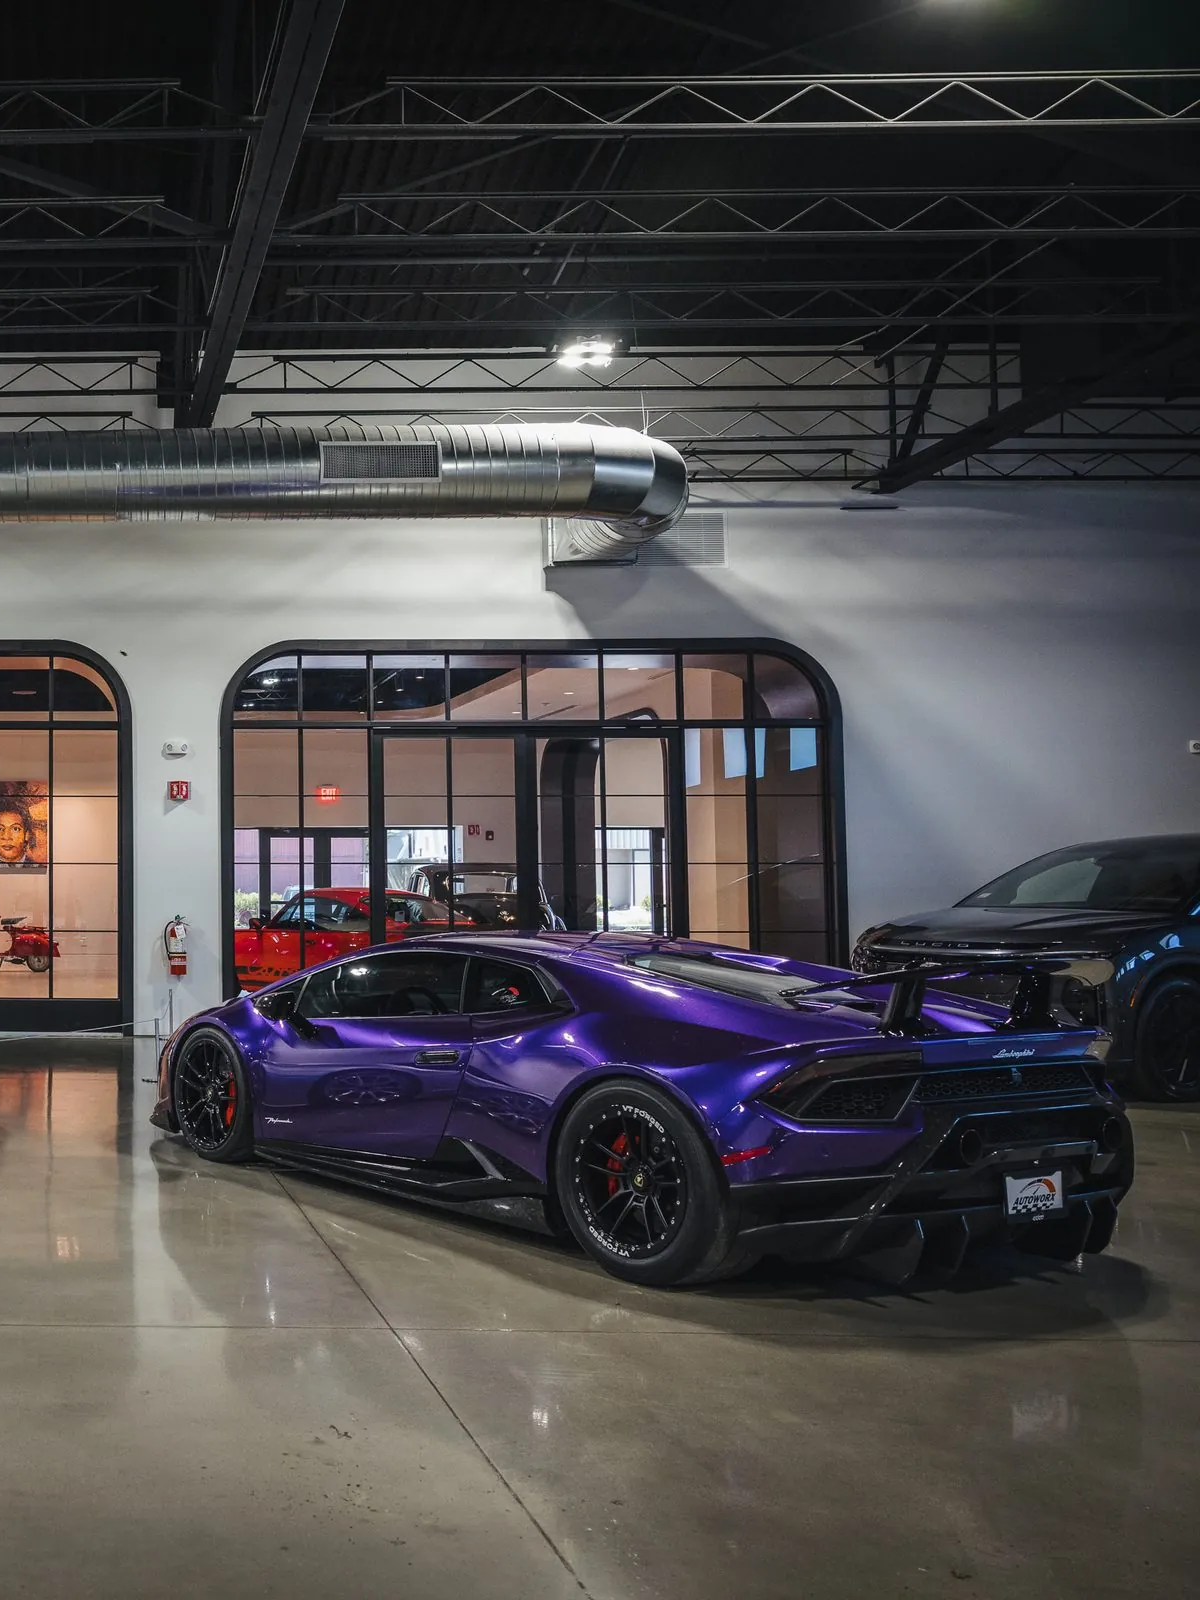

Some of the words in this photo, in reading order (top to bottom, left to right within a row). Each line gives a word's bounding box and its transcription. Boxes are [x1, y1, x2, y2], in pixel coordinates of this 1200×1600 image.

[321, 788, 337, 800] EXIT
[900, 940, 969, 948] LUCID
[622, 1104, 634, 1113] VT
[634, 1107, 665, 1134] FORGED
[1012, 1192, 1056, 1206] AUTOWORX
[589, 1225, 618, 1253] FORGED
[617, 1249, 630, 1258] VT
